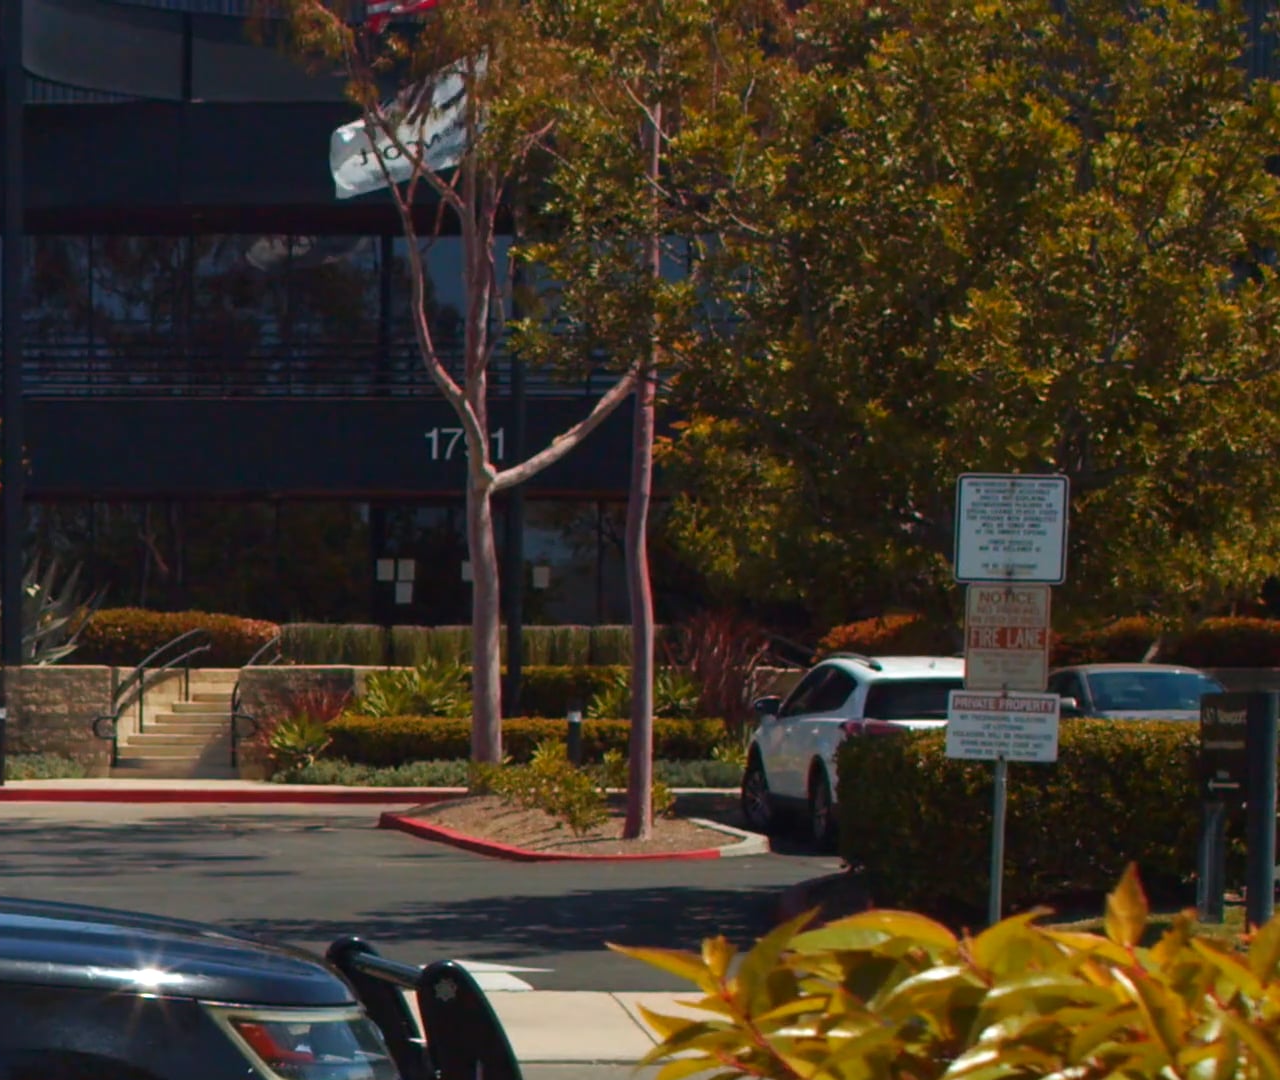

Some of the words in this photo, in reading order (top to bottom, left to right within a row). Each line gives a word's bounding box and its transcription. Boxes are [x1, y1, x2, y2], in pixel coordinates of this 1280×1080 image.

[425, 427, 505, 460] 171
[971, 628, 1001, 648] FIRE
[1007, 628, 1044, 648] LANE
